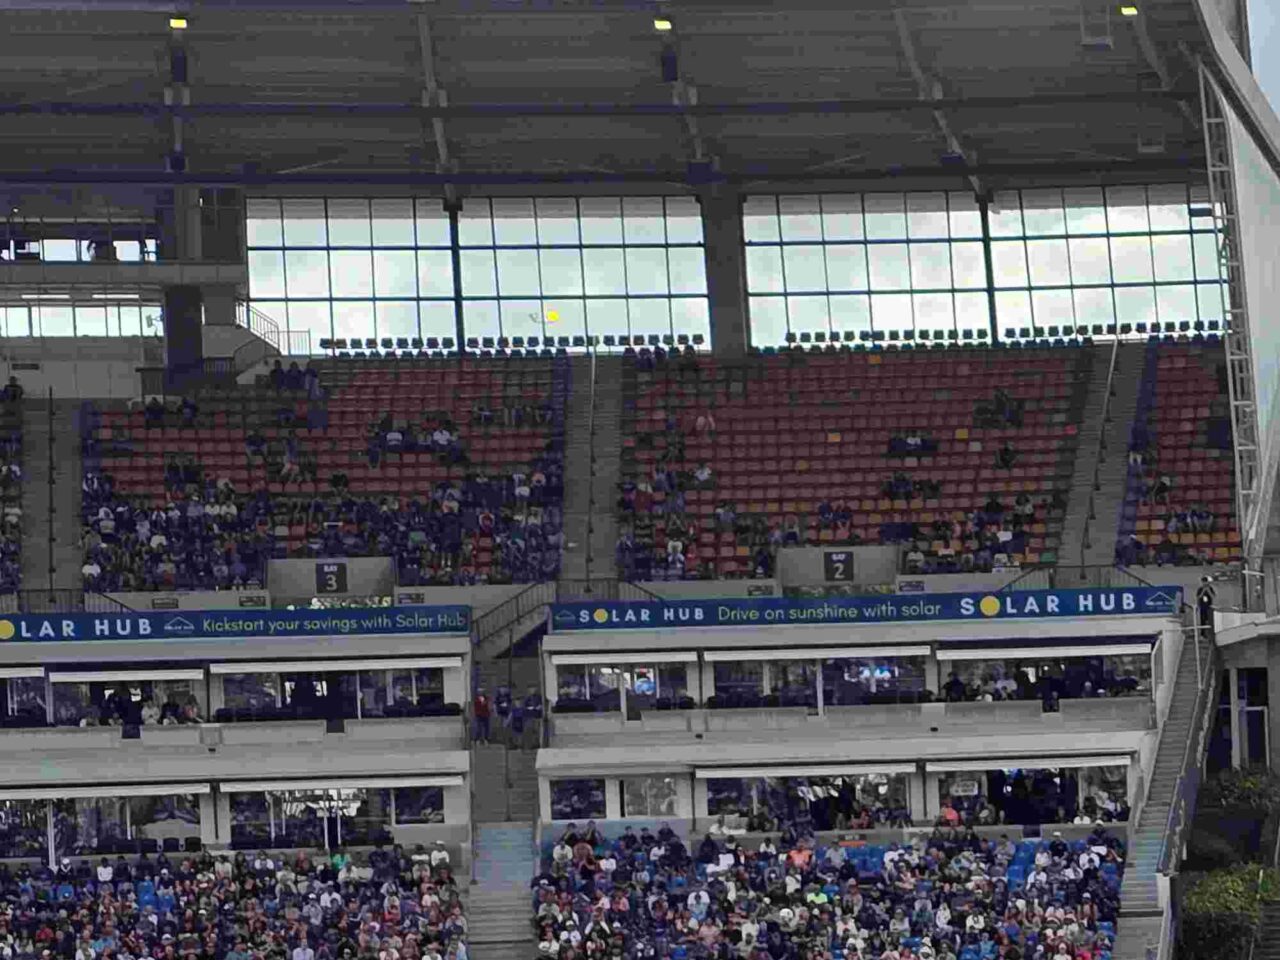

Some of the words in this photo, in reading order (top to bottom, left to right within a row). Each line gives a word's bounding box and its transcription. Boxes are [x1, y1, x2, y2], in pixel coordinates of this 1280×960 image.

[833, 563, 845, 579] 2
[326, 574, 337, 591] 3
[718, 606, 759, 621] Drive
[764, 608, 784, 620] on
[789, 602, 858, 619] sunshine
[863, 601, 896, 617] with
[901, 601, 941, 616] solar
[960, 595, 1059, 616] SOLAR
[1078, 593, 1135, 611] HUB
[579, 608, 650, 623] SOLAR
[664, 606, 704, 621] HUB
[95, 619, 151, 636] HUB
[203, 616, 264, 632] Kickstart
[268, 619, 298, 637] your
[303, 616, 357, 633] savings
[361, 613, 392, 629] with
[396, 612, 434, 628] Solar
[438, 612, 465, 627] Hub
